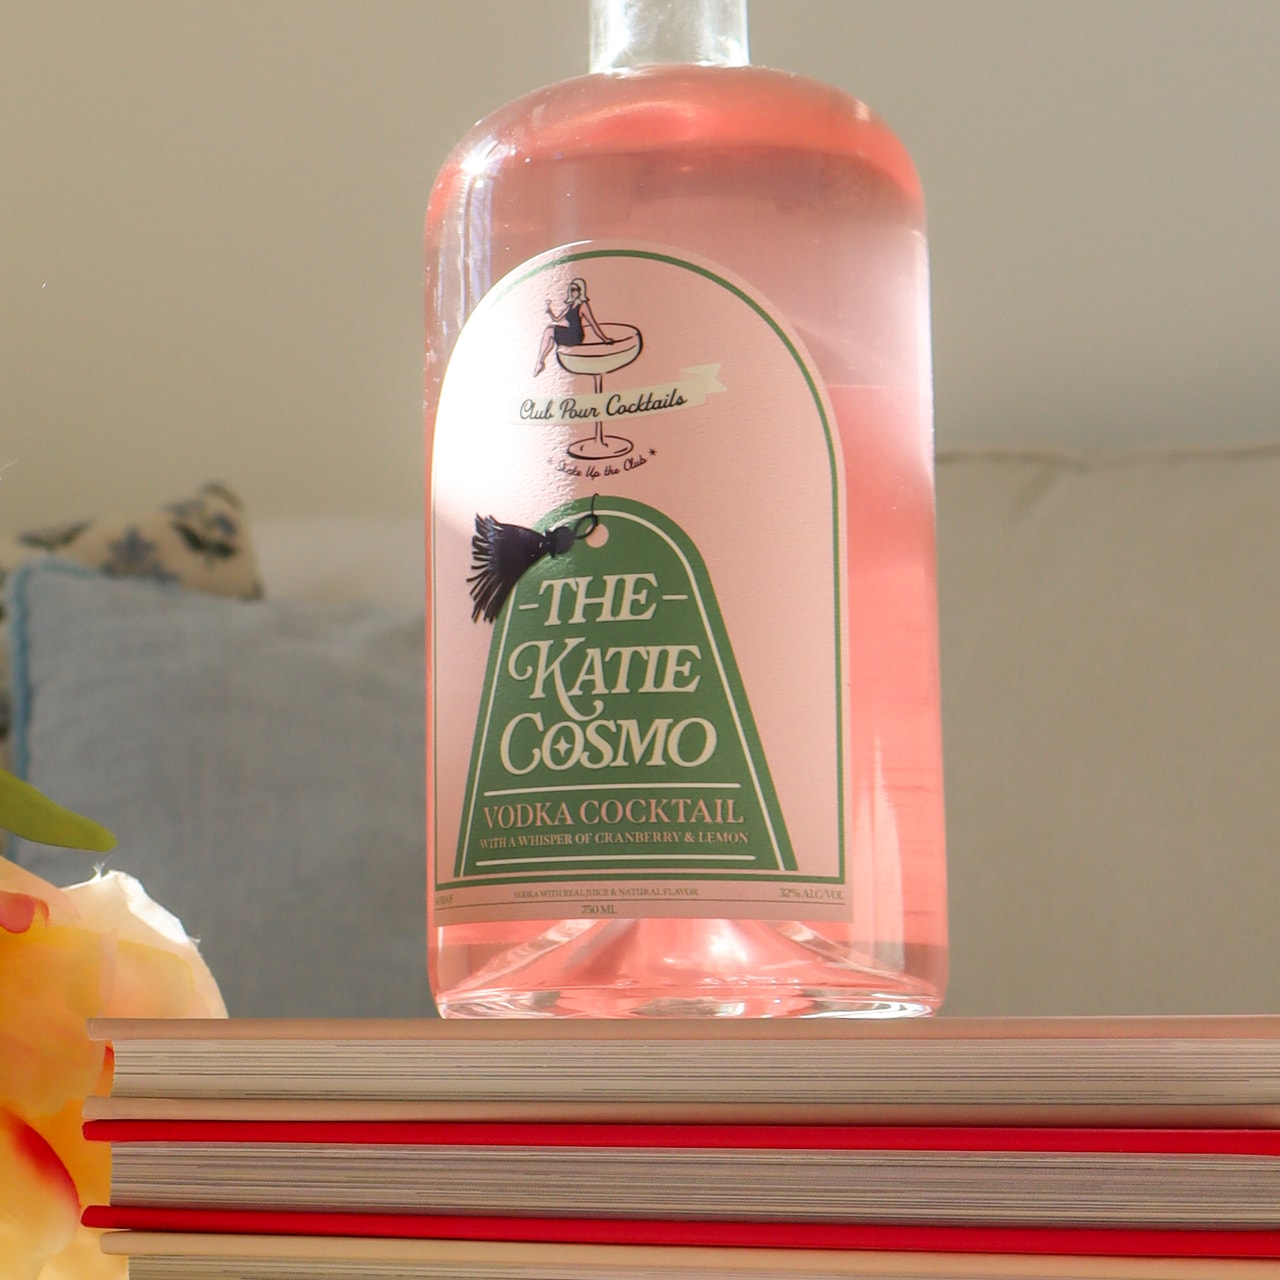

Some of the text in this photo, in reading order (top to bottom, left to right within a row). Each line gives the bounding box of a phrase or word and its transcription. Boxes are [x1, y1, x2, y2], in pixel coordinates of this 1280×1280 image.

[519, 388, 688, 420] Club Pour Cocktails
[585, 465, 601, 480] Up
[604, 465, 621, 476] the
[623, 454, 648, 471] Club
[538, 572, 659, 627] THE
[507, 636, 702, 721] KATIE
[500, 711, 718, 775] COSMO
[483, 798, 745, 830] VODKA COCKTAIL
[480, 831, 750, 849] WITH A WHISPER OF CRANBERRY & LEMON
[513, 890, 539, 898] VODKA
[540, 889, 562, 897] WITH
[563, 888, 585, 897] REAL
[585, 888, 609, 897] JUICE
[619, 887, 662, 896] NATURAL
[663, 887, 699, 896] FLAVOR
[779, 887, 801, 898] 32%
[581, 904, 618, 915] 750 ML
